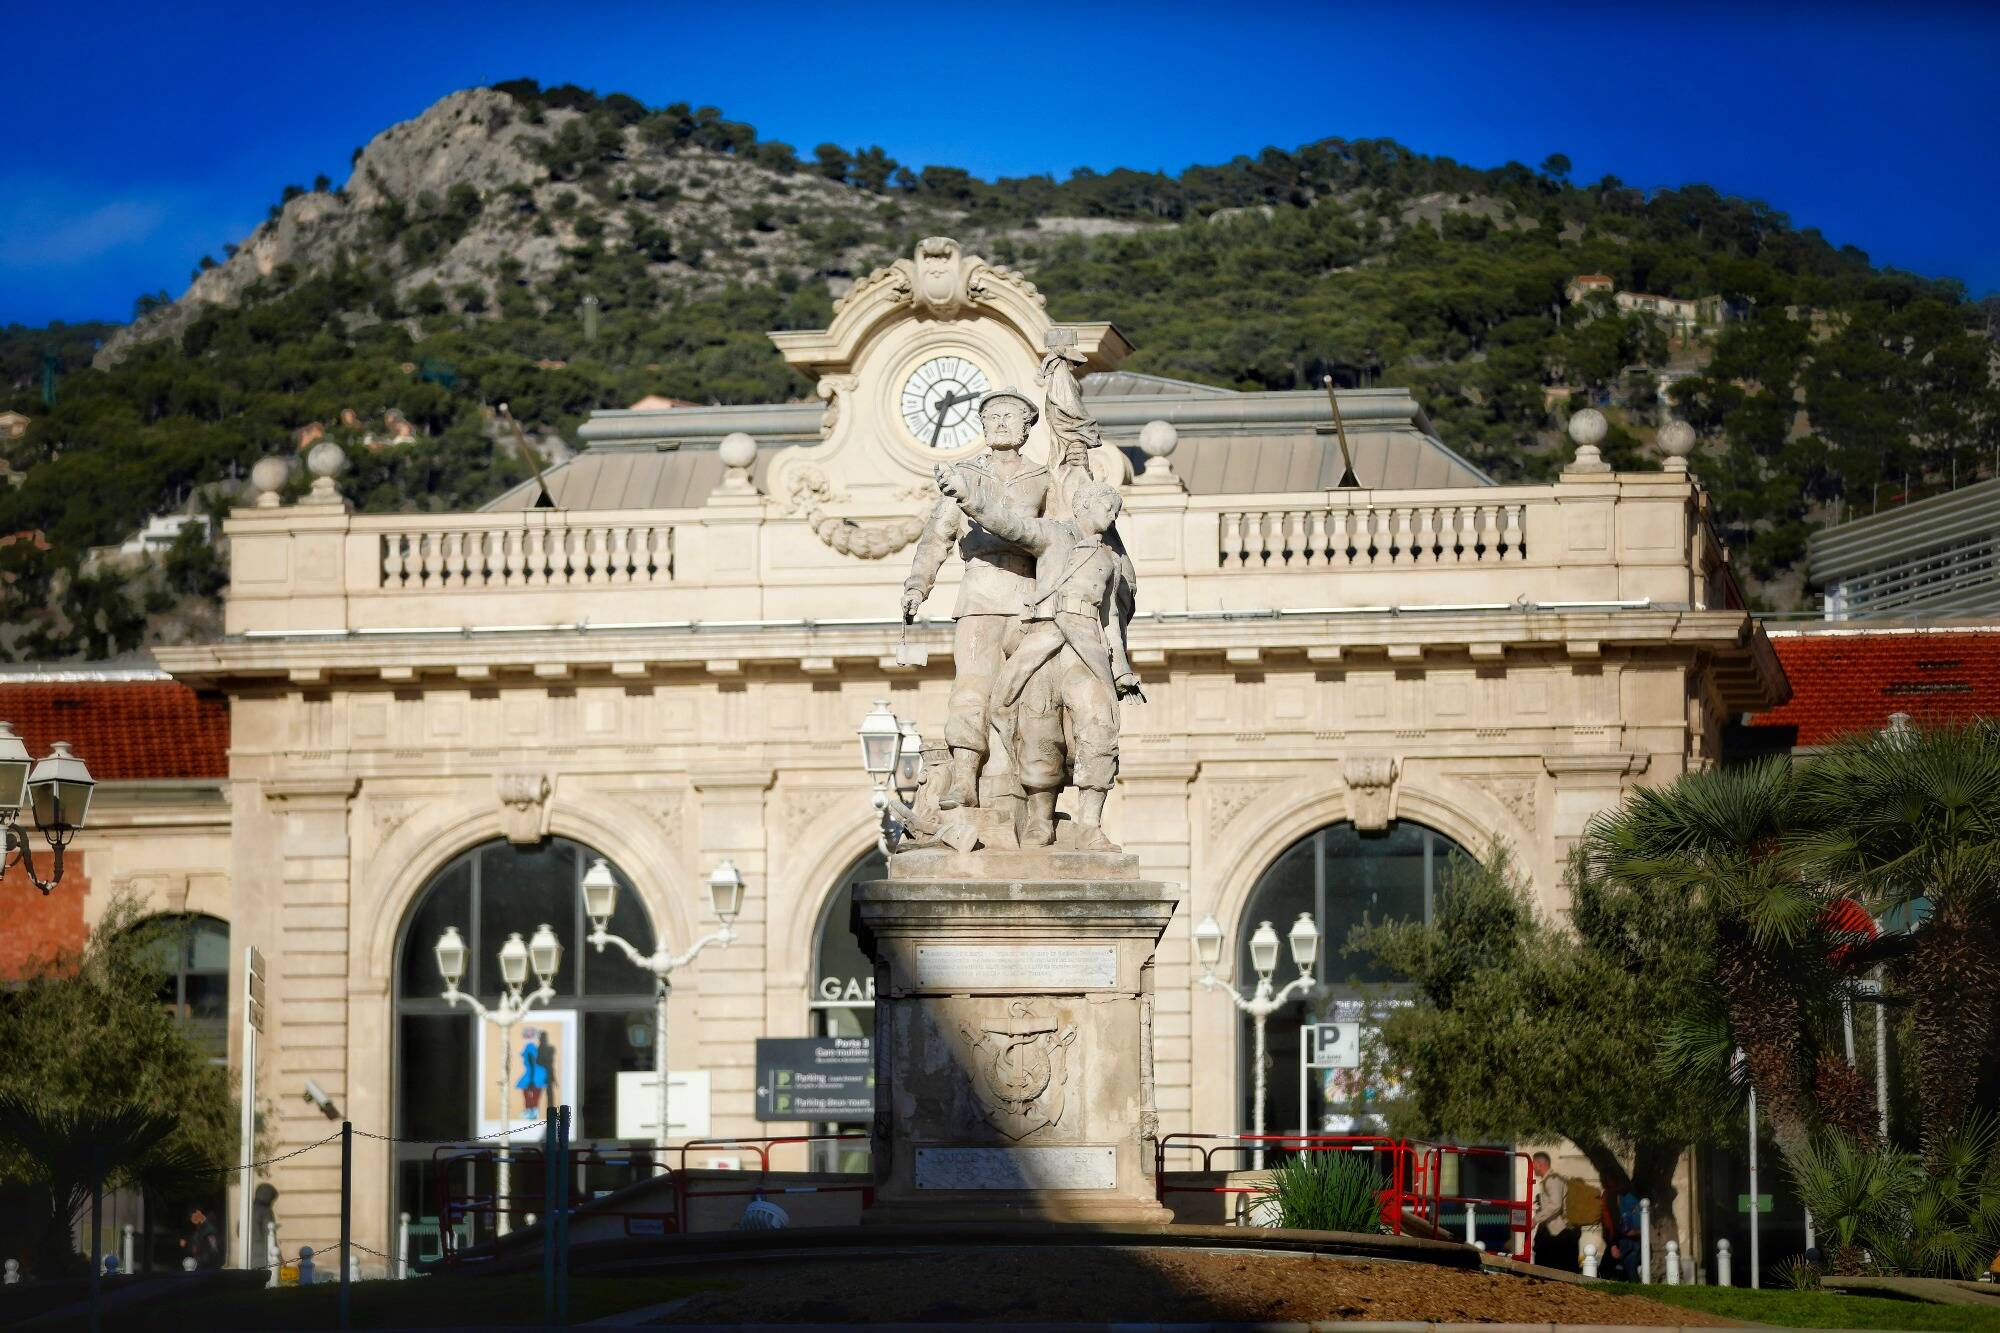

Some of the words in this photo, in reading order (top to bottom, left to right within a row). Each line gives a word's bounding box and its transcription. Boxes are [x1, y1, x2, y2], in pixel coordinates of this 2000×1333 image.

[1319, 1026, 1340, 1051] P
[795, 1073, 827, 1084] Parking
[795, 1097, 826, 1108] Parking
